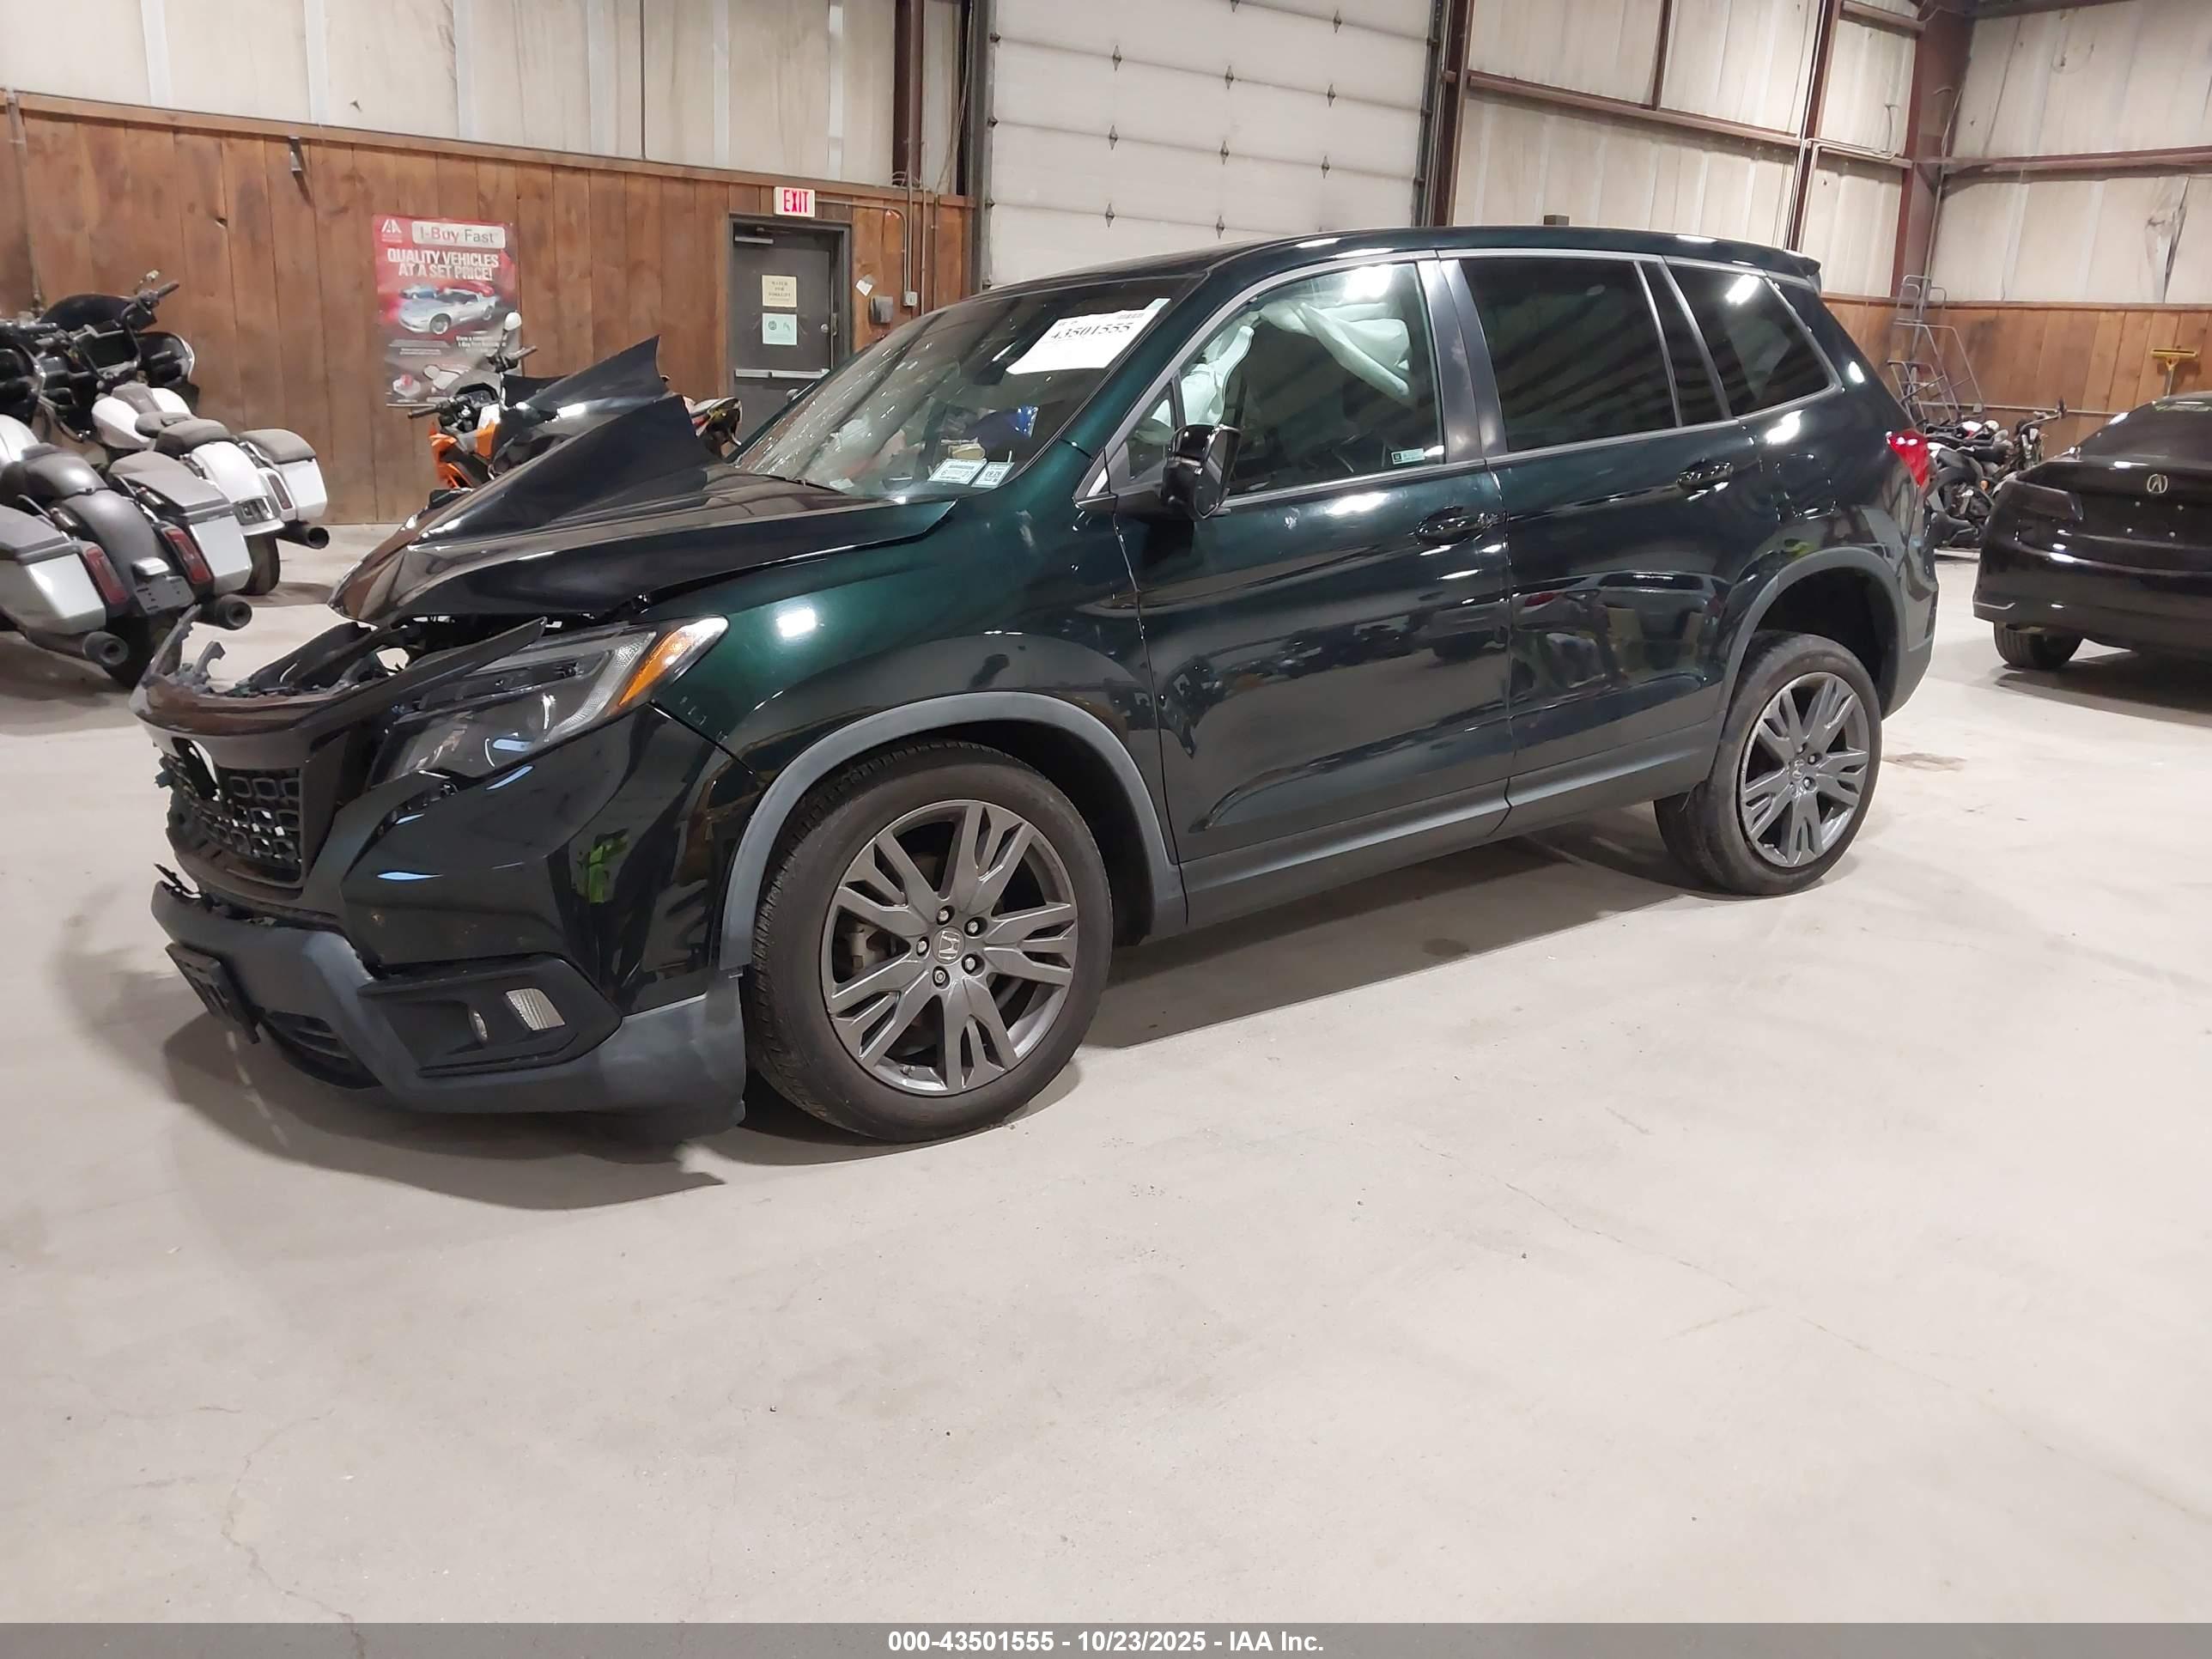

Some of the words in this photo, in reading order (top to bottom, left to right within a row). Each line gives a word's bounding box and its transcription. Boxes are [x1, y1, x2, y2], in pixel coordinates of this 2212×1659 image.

[784, 190, 809, 213] EXIT
[420, 226, 459, 242] I-Buy
[464, 229, 495, 244] Fast
[387, 247, 440, 264] QUALITY
[442, 252, 499, 269] VEHICLES
[398, 263, 416, 276] AT
[418, 264, 427, 276] A
[429, 265, 453, 278] SET
[455, 268, 494, 282] PRICE!
[1051, 322, 1133, 339] 43501555
